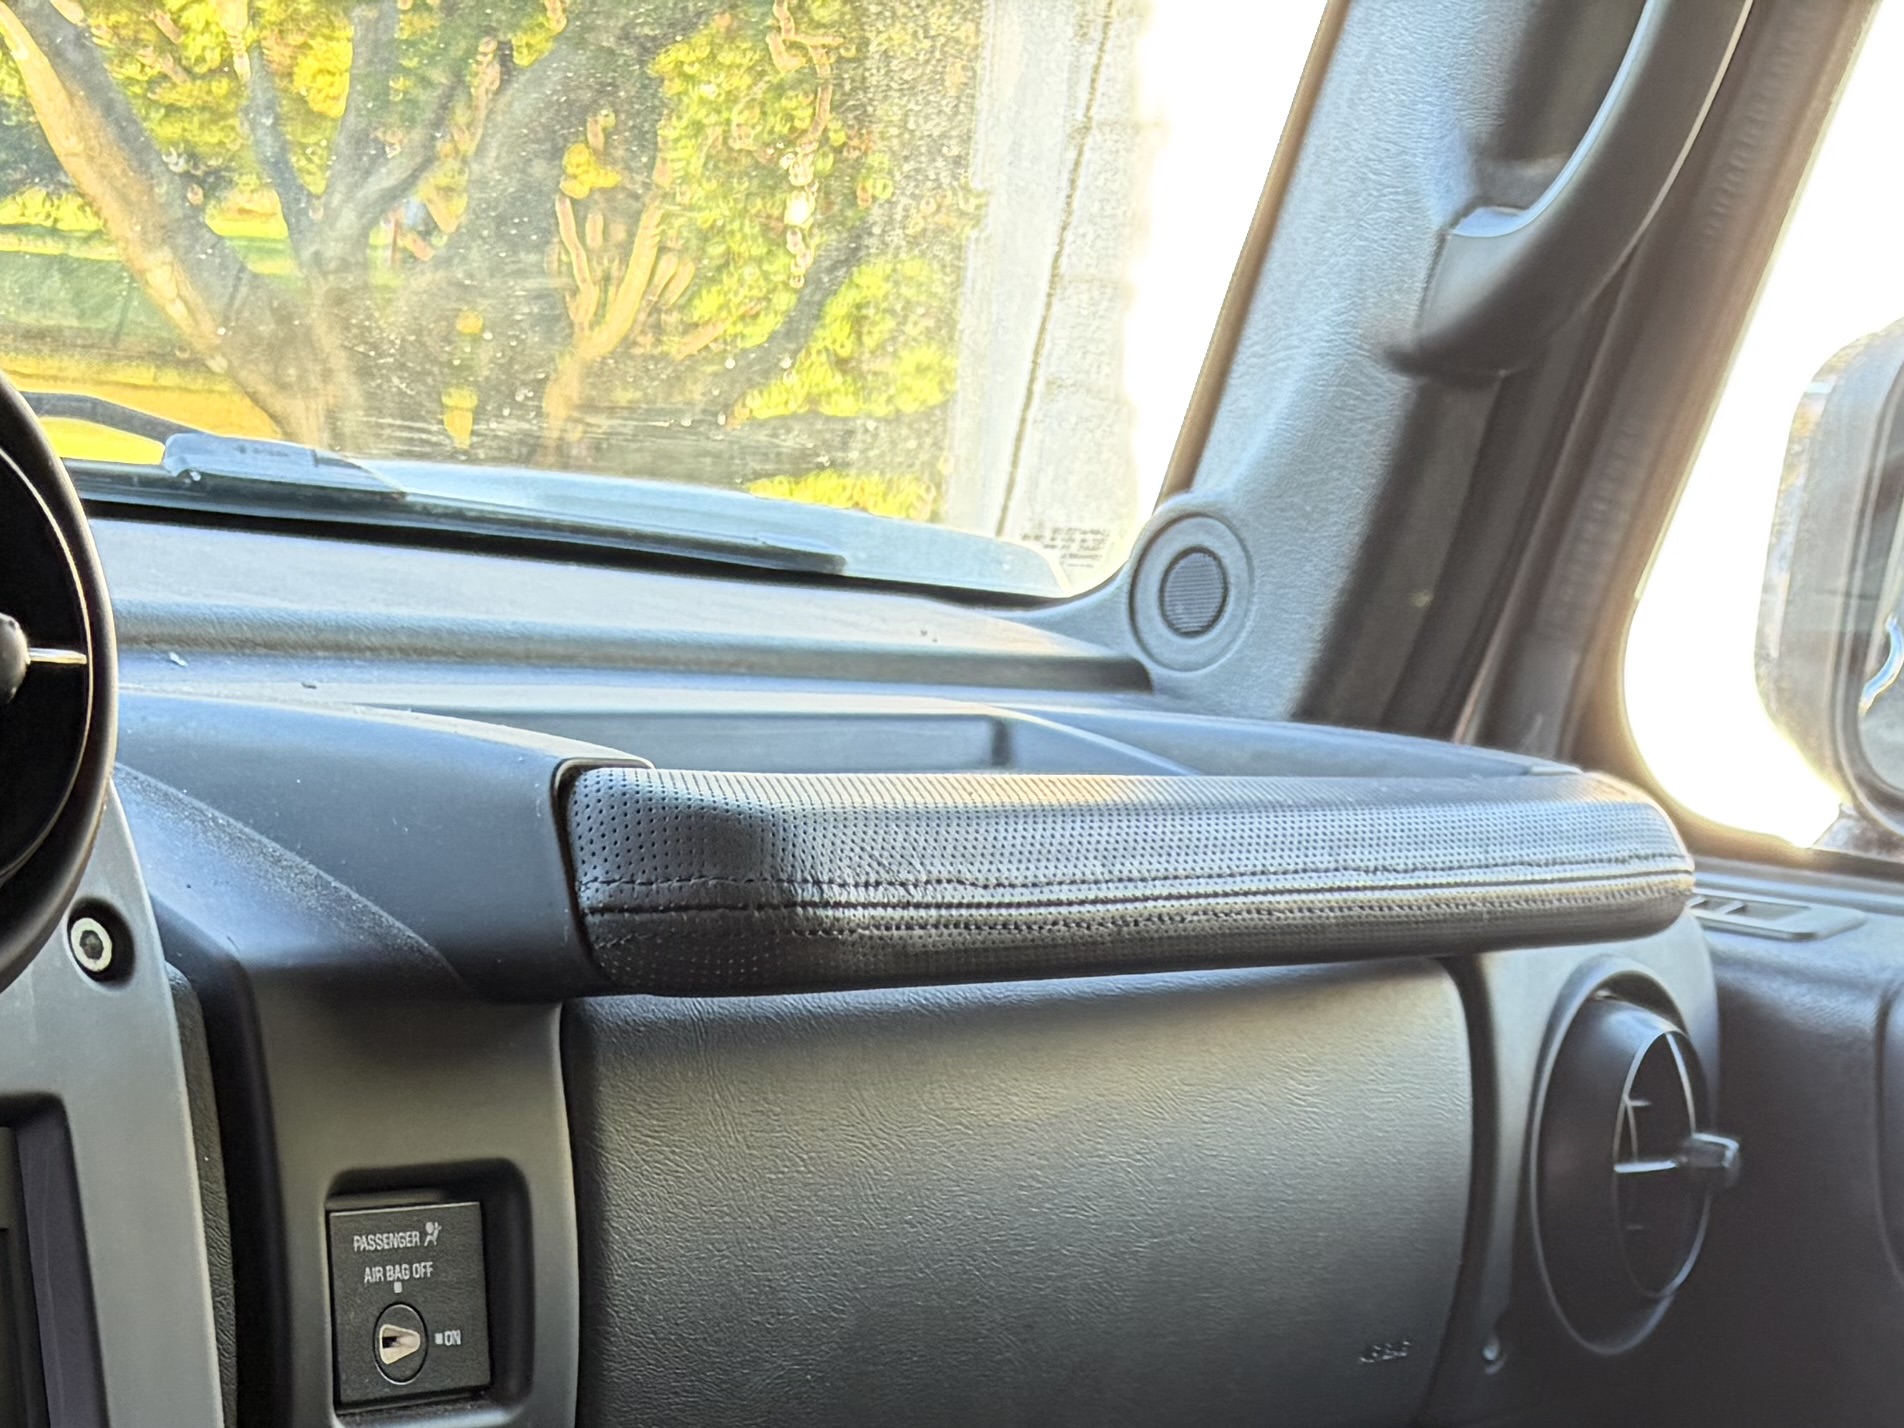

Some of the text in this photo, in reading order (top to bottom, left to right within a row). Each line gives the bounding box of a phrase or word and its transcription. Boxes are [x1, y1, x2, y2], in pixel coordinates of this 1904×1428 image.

[353, 1231, 421, 1252] PASSENGER
[364, 1261, 434, 1284] AIR BAG OFF
[444, 1329, 462, 1346] ON
